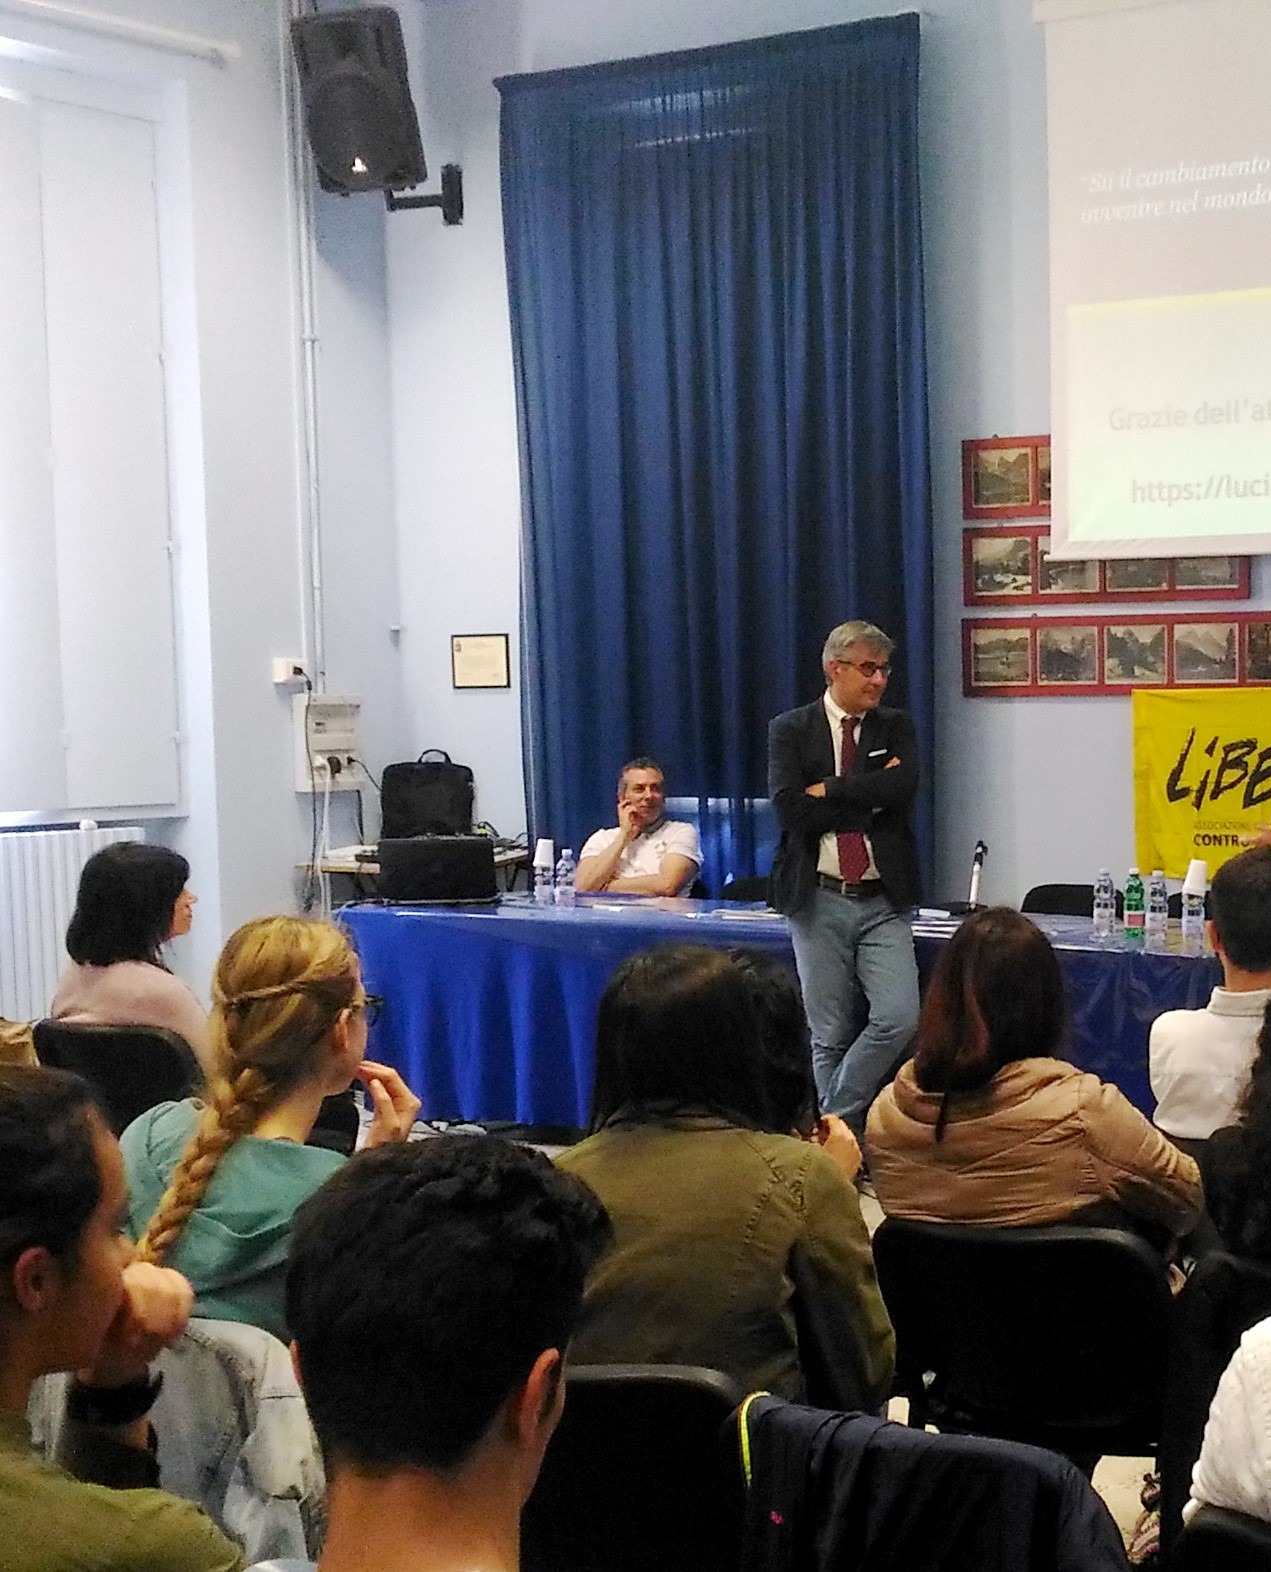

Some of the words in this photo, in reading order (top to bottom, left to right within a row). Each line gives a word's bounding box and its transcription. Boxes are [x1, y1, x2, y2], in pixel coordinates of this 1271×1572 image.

[1119, 167, 1132, 189] il
[1136, 156, 1270, 188] cambiamento
[1081, 197, 1165, 224] avvenire
[1170, 189, 1199, 214] nel
[1108, 406, 1188, 431] Grazie
